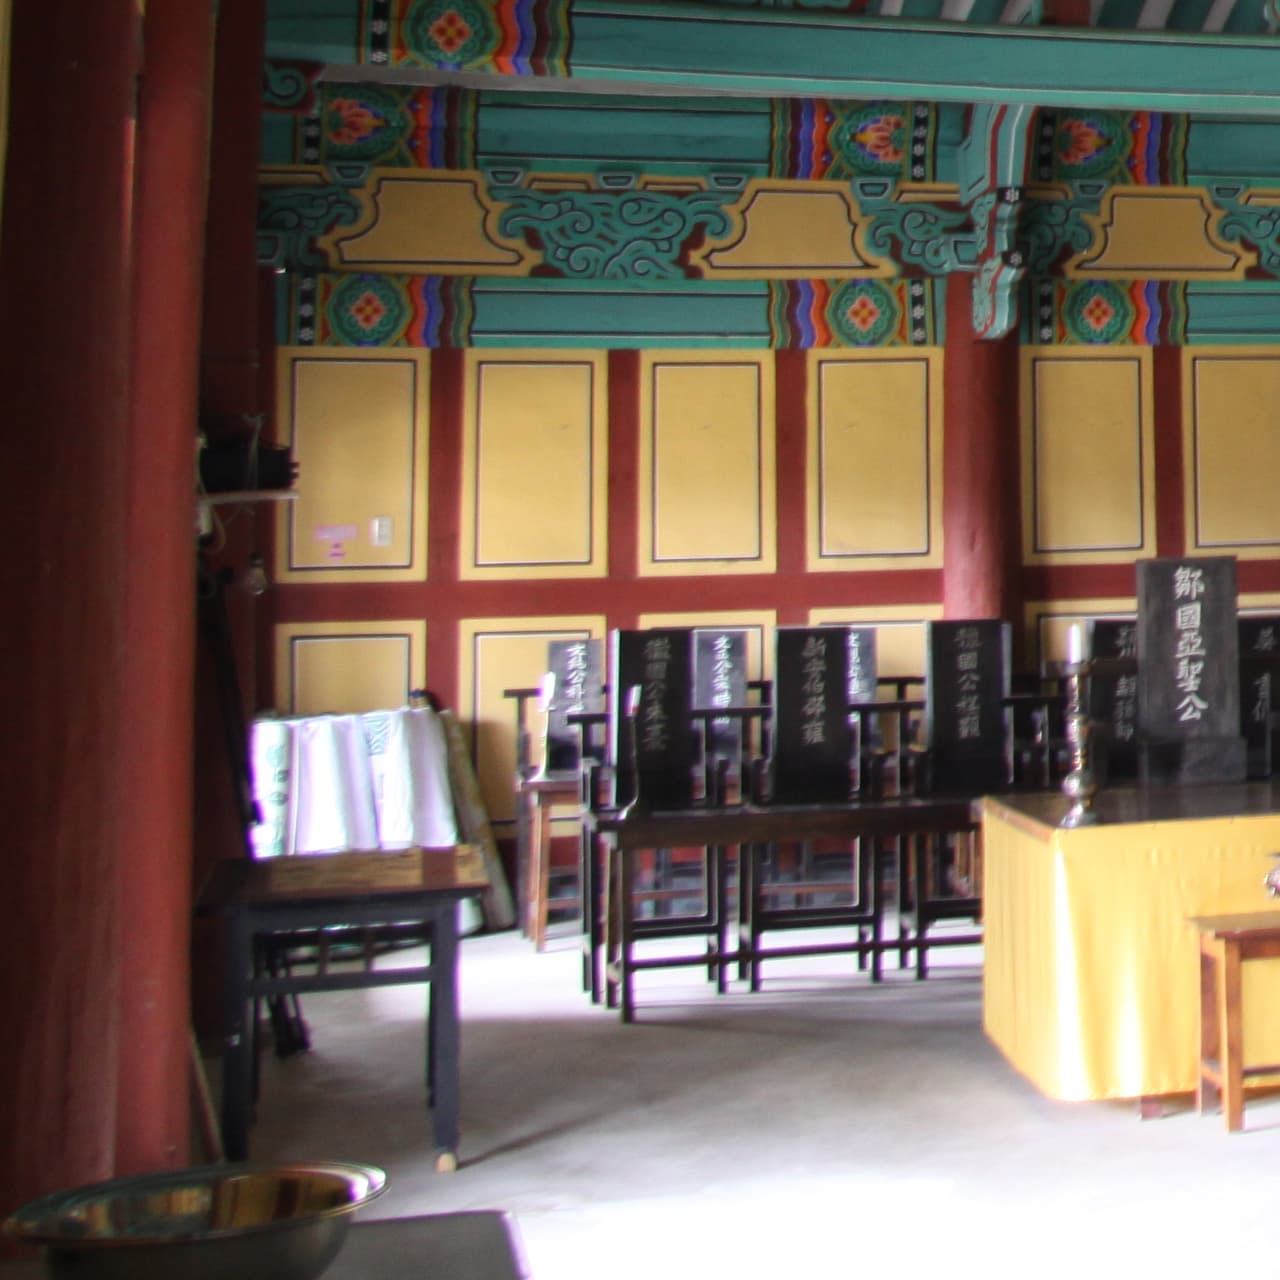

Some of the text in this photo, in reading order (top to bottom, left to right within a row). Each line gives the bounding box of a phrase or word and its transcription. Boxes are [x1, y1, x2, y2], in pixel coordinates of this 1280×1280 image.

[1174, 566, 1208, 721] 鄒國亞聖公
